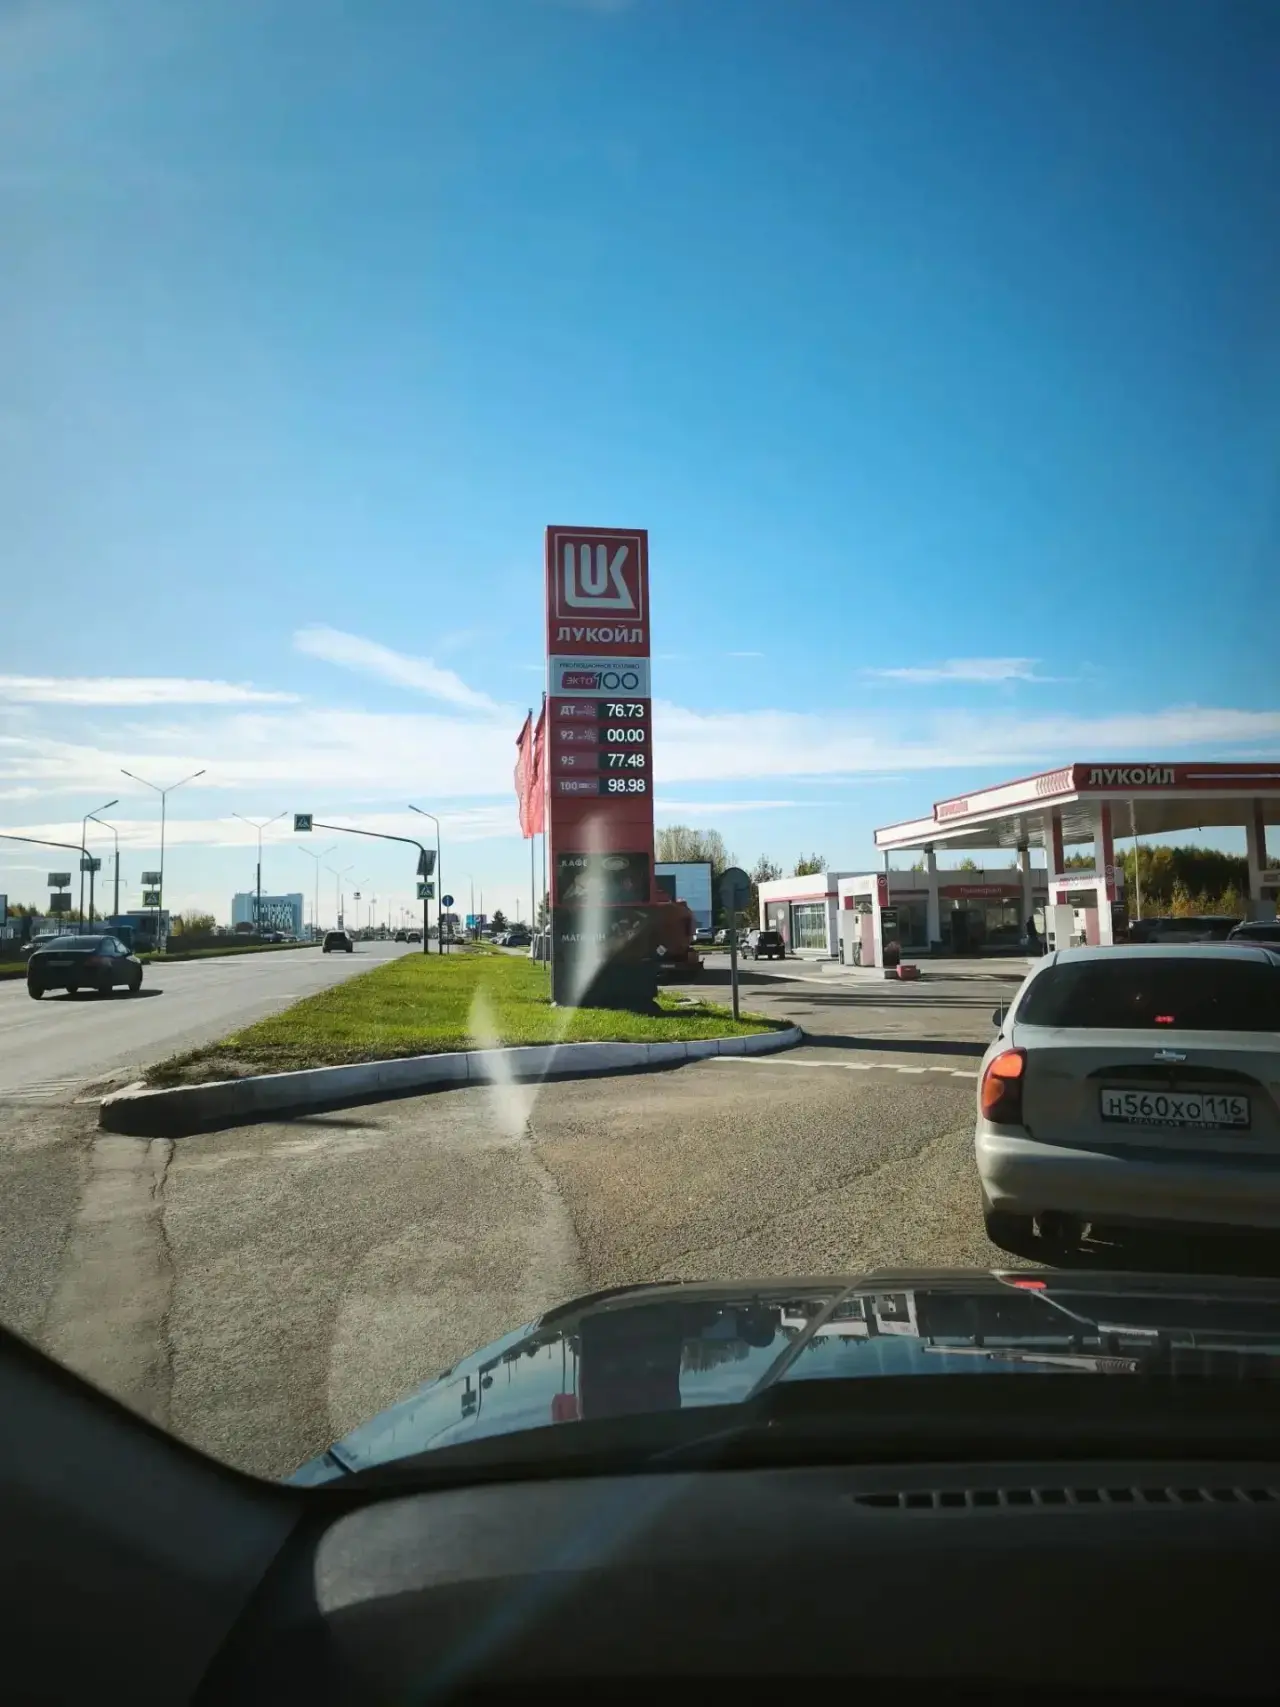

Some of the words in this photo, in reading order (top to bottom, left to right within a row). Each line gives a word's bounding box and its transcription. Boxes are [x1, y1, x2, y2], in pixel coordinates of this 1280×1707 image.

[556, 625, 643, 643] ЛУКОЙЛ
[595, 672, 639, 690] 100
[560, 705, 575, 715] ДТ
[606, 703, 644, 717] 76.73
[560, 730, 574, 740] 92
[607, 729, 645, 742] 00.00
[561, 755, 575, 765] 95
[607, 753, 645, 767] 77.48
[1088, 764, 1176, 785] ЛУКОЙЛ
[560, 781, 577, 791] 100
[607, 778, 646, 792] 98.98
[1205, 1096, 1243, 1116] 116
